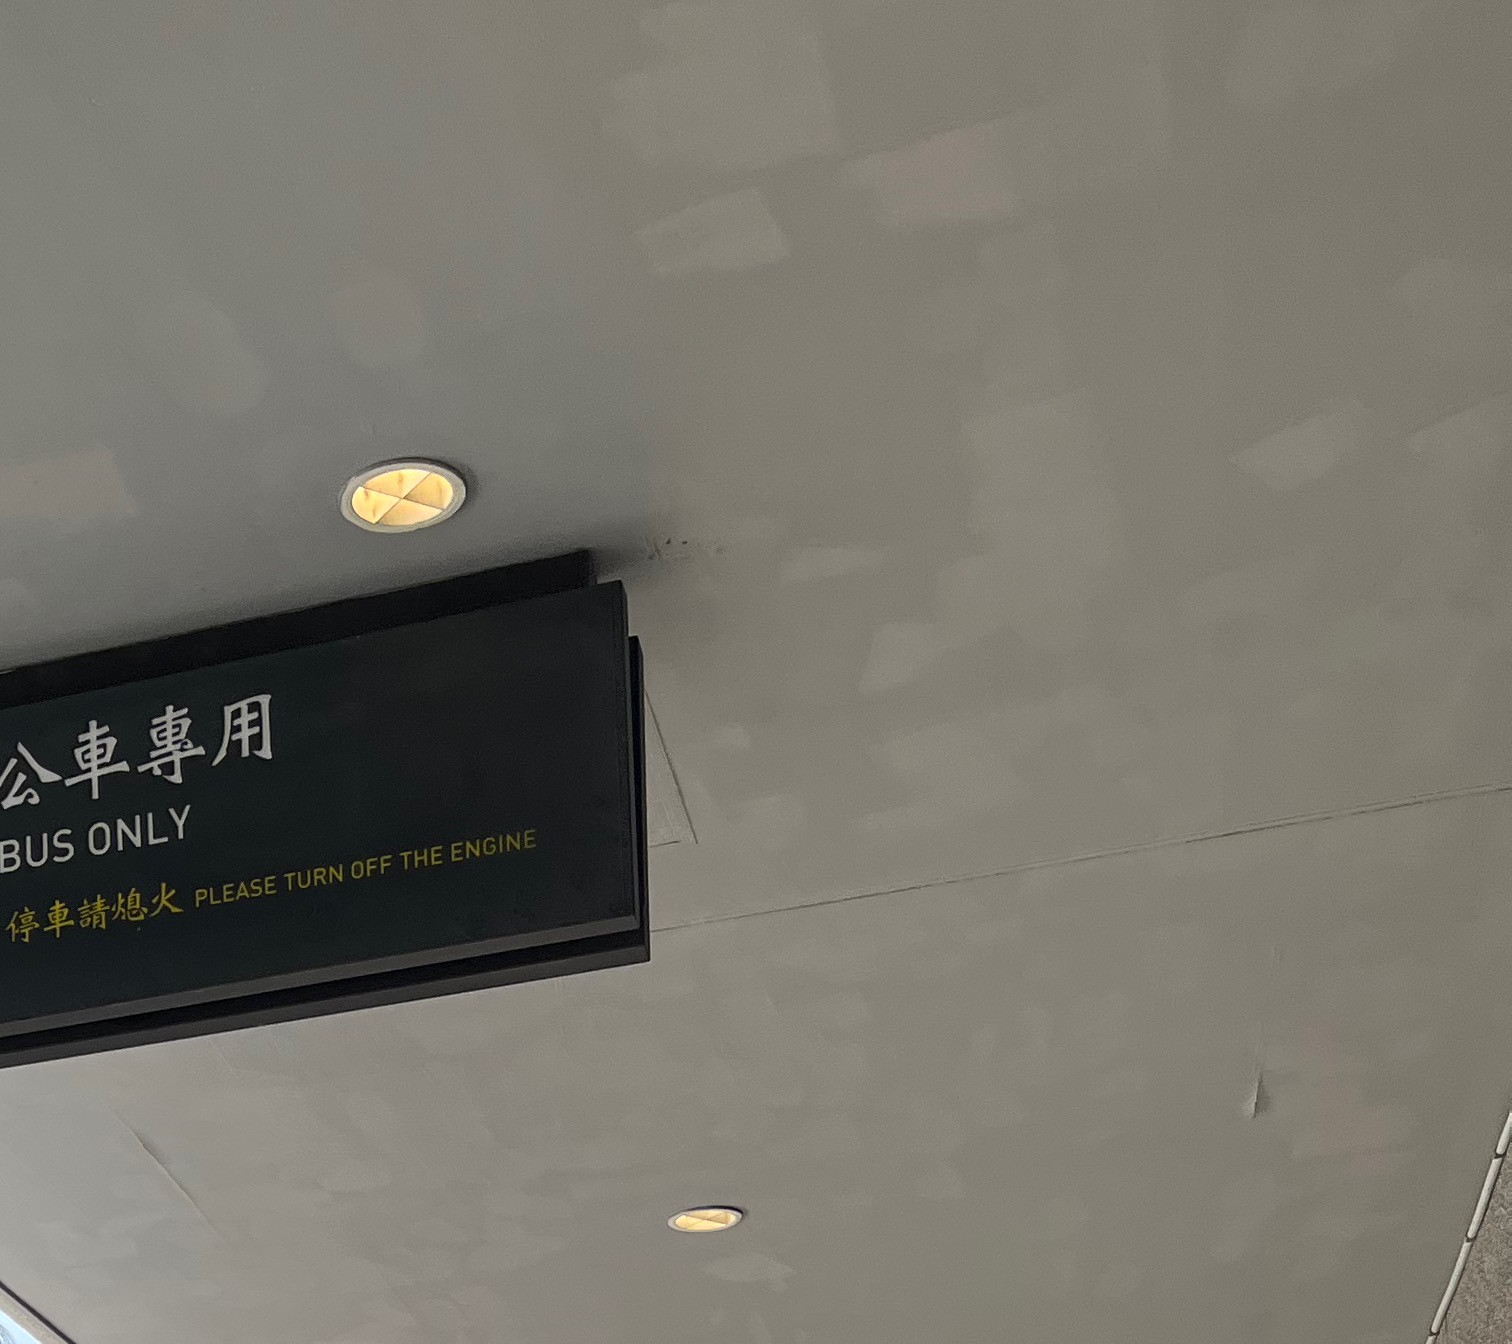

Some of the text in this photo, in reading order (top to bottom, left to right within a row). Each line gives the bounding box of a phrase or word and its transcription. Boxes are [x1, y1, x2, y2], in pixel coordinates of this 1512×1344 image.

[88, 805, 192, 858] ONLY
[194, 830, 538, 909] PLEASE TURN OFF THE ENGINE
[6, 883, 184, 943] 停車請熄火
